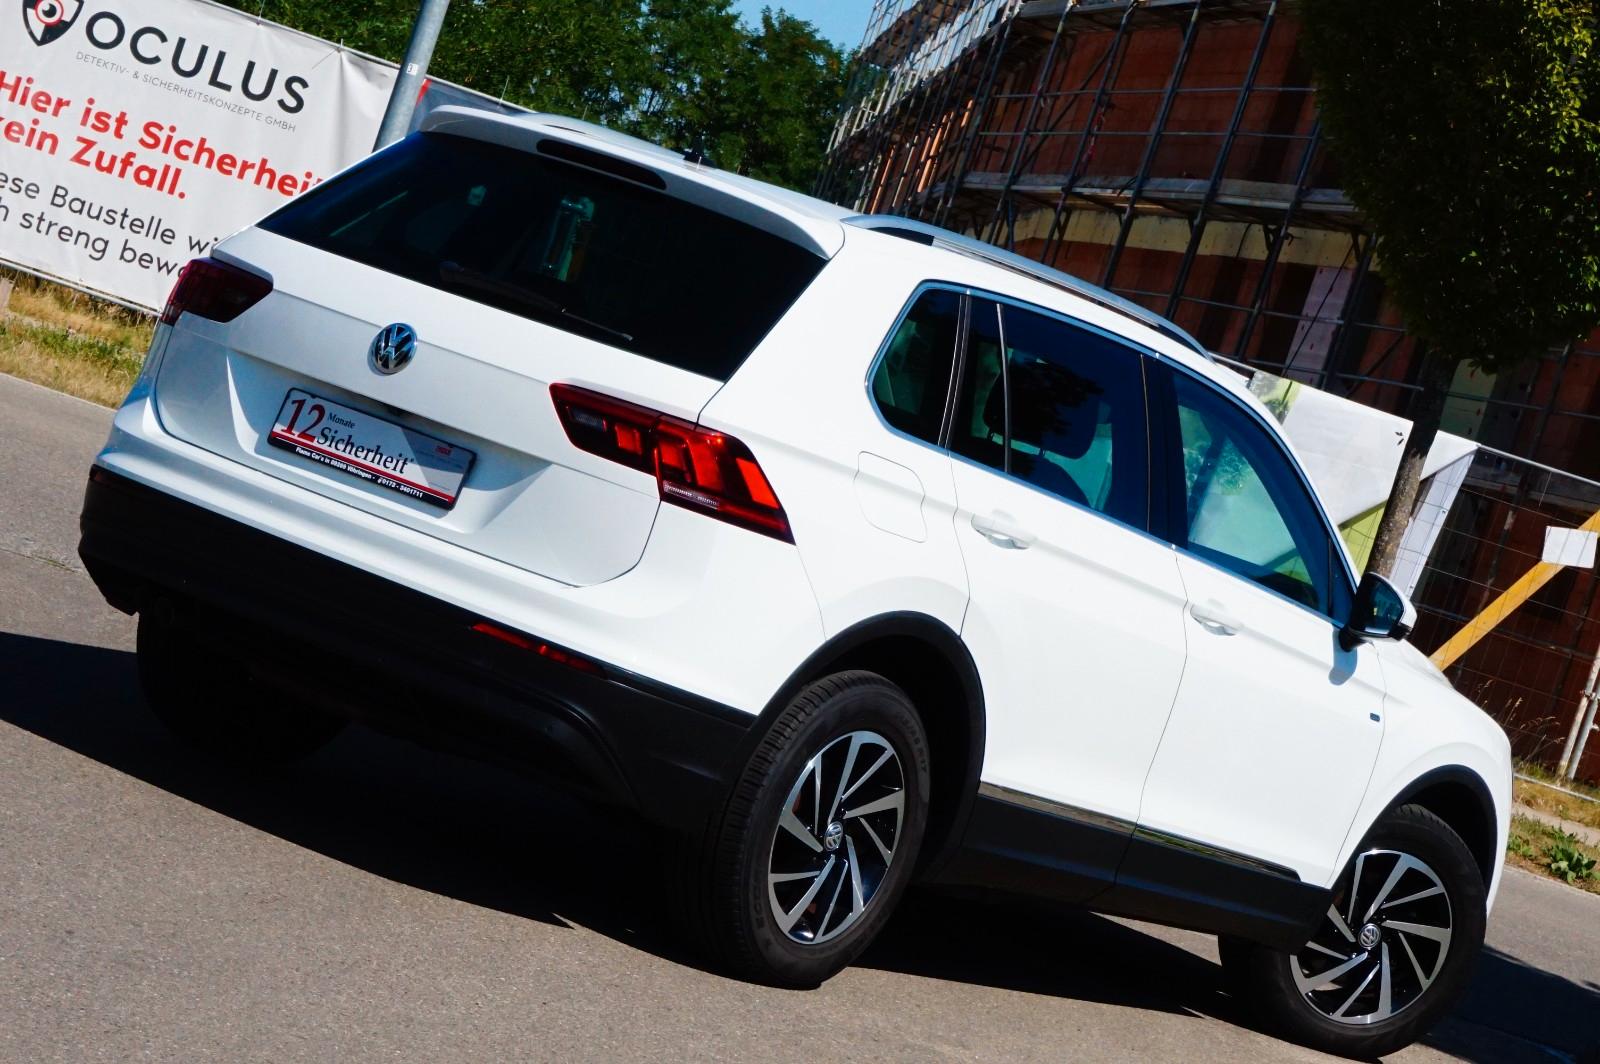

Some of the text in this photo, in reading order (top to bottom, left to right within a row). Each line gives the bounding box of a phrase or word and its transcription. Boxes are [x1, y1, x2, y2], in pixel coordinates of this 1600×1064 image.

[76, 51, 297, 133] DETEKTIV- & SICHERHEITSKONZEPTE GMBH
[85, 11, 310, 113] OCULUS
[0, 70, 325, 197] Hier ist Sicherhei
[0, 117, 186, 199] ein Zufall.
[20, 211, 109, 261] streng
[119, 239, 186, 277] bew
[50, 185, 176, 245] Baustelle
[281, 398, 356, 443] 12 Monate
